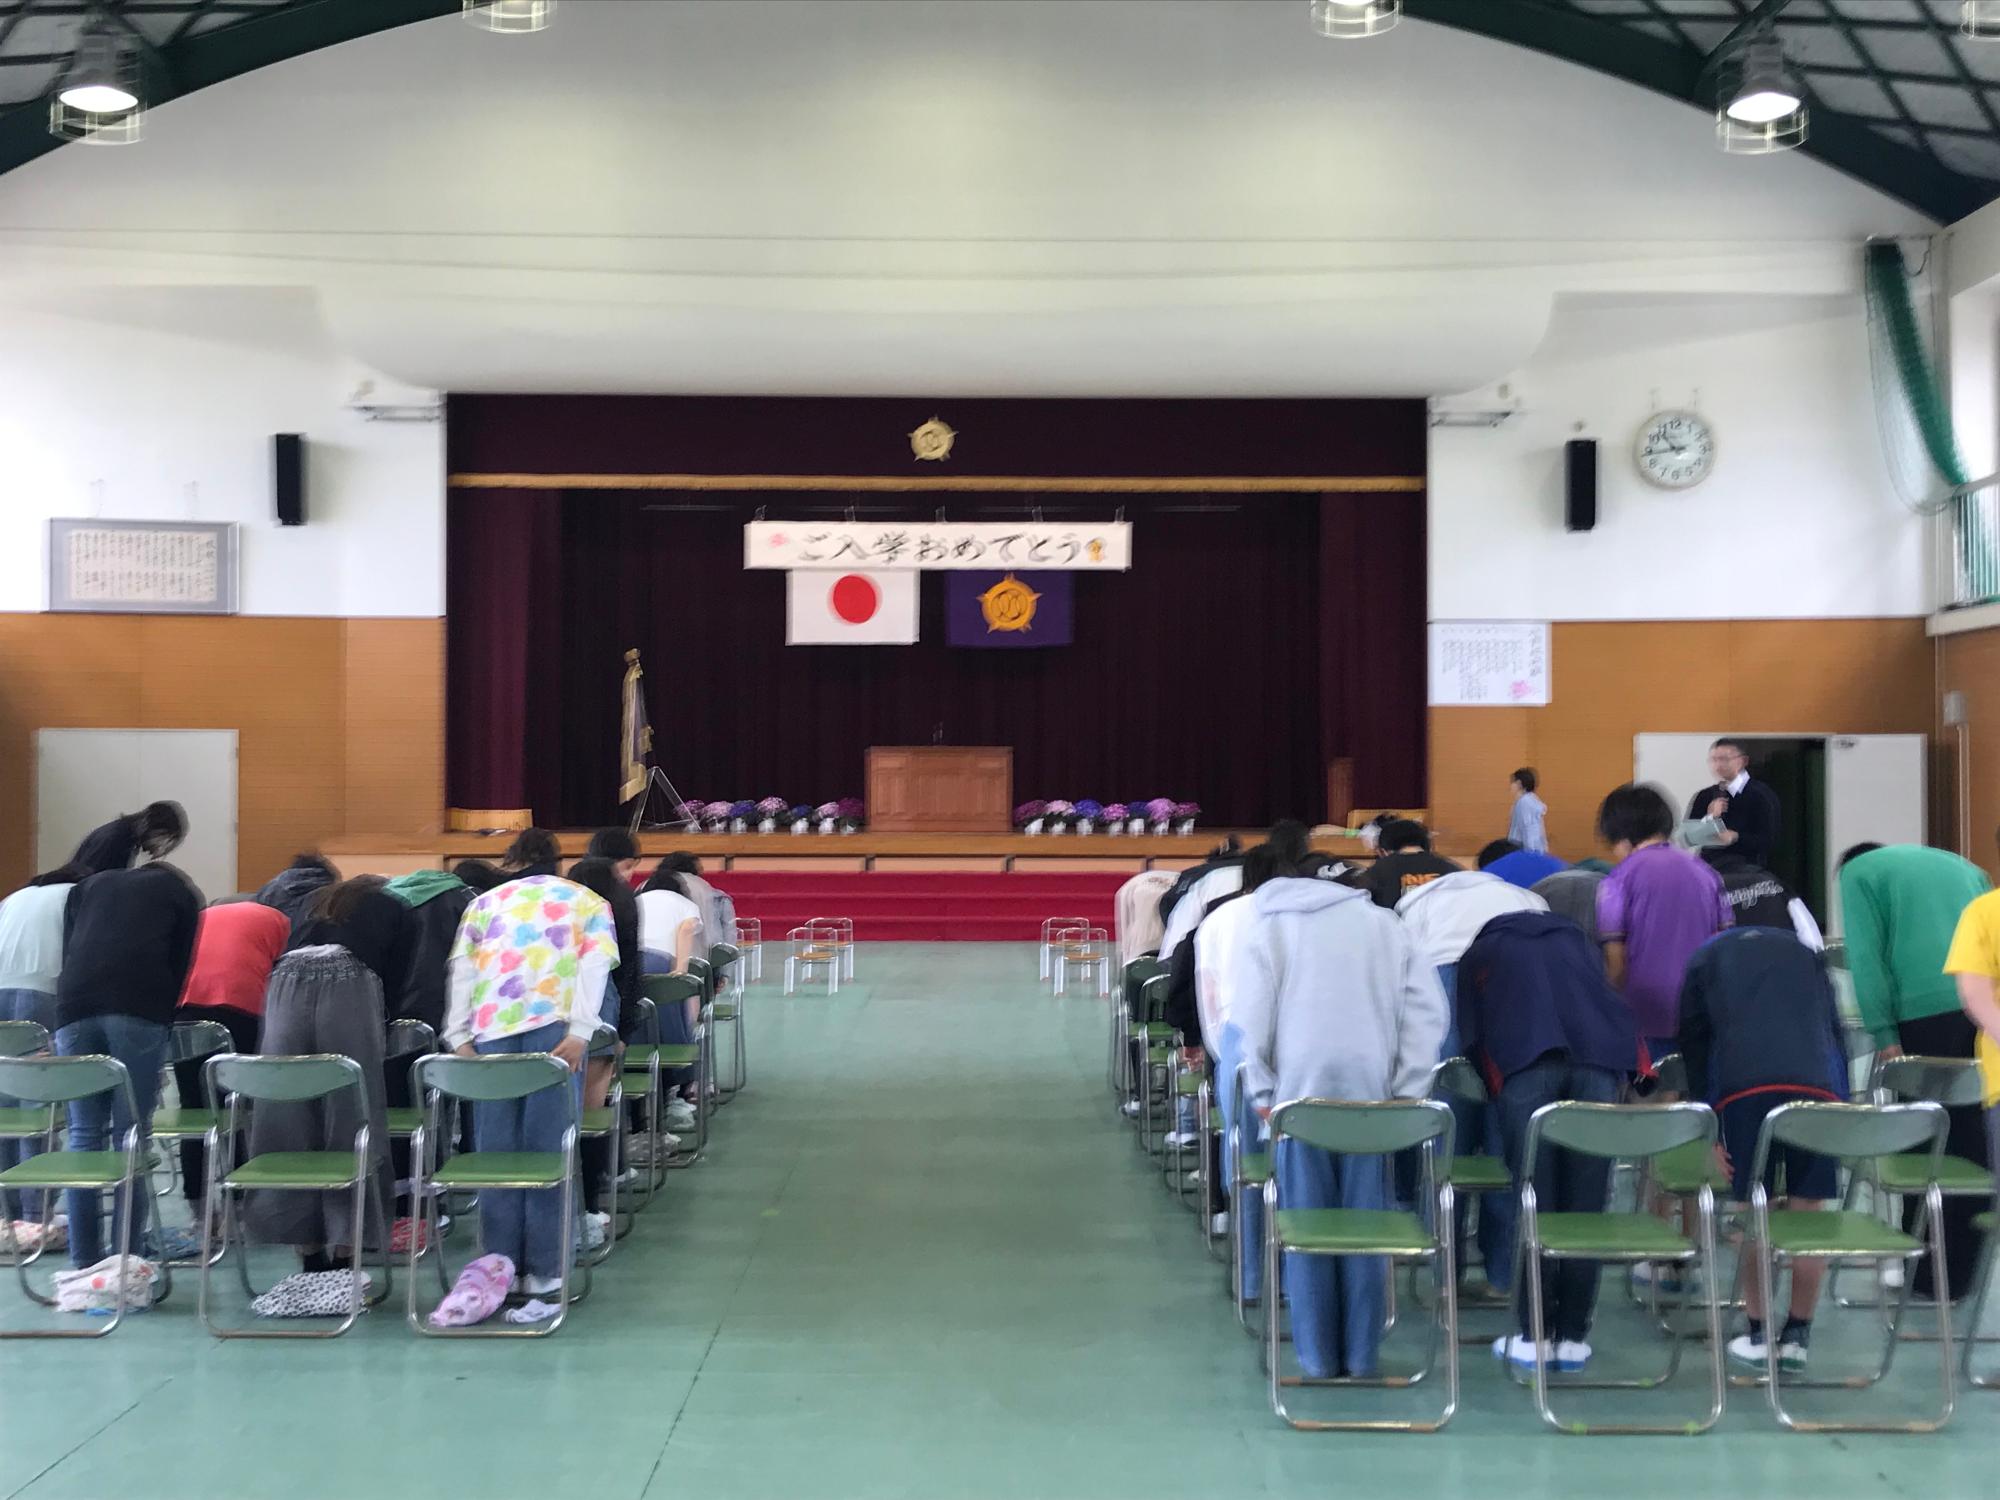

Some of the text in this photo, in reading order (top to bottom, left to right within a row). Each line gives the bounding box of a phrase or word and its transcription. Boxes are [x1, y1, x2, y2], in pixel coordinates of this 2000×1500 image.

[1669, 419, 1681, 430] 12
[1648, 433, 1660, 444] 10
[1649, 458, 1657, 468] 8
[1671, 470, 1680, 480] 6
[799, 531, 1082, 563] ご入学おめでとう
